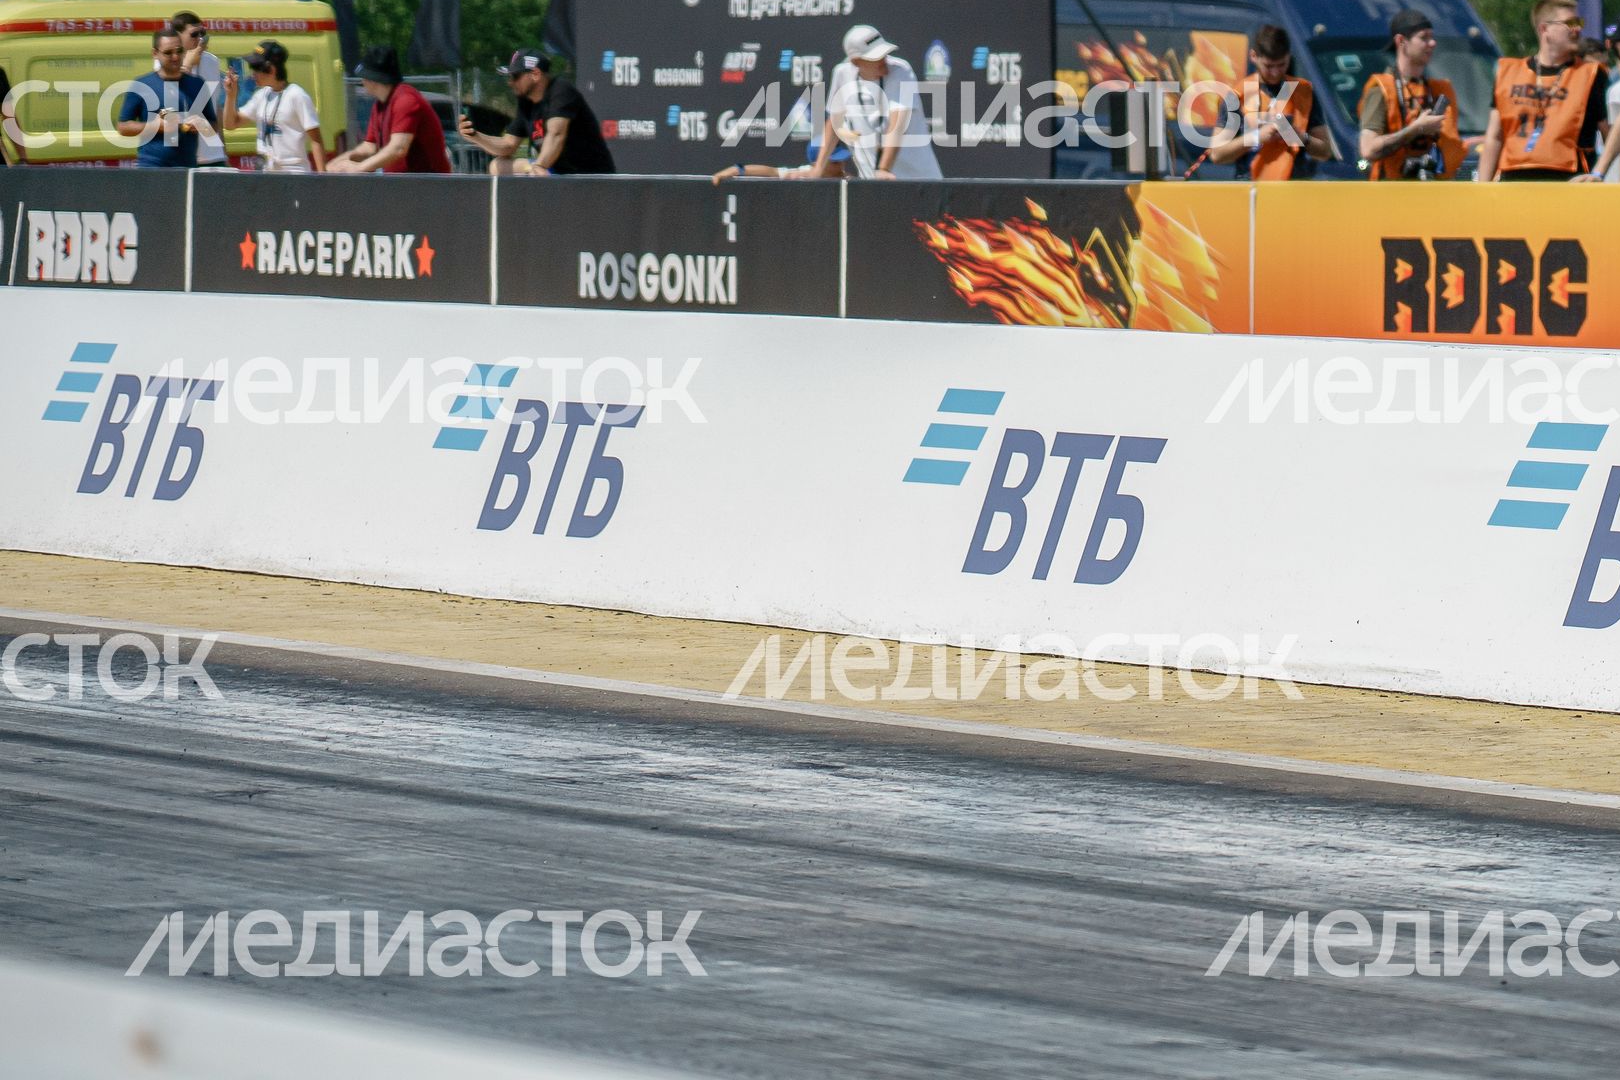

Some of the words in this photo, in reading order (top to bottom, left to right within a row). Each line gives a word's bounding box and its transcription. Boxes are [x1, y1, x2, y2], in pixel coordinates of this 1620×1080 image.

[613, 56, 640, 86] ВТБ
[791, 56, 823, 86] ВТБ
[987, 53, 1021, 84] ВТБ
[679, 111, 707, 141] ВТБ
[27, 210, 138, 284] RDRC
[257, 230, 416, 281] RACEPARK
[578, 251, 737, 305] ROSGONKI
[1381, 237, 1588, 337] RDRC
[77, 373, 224, 501] ВТБ
[477, 398, 646, 538] ВТБ
[961, 428, 1168, 585] ВТБ
